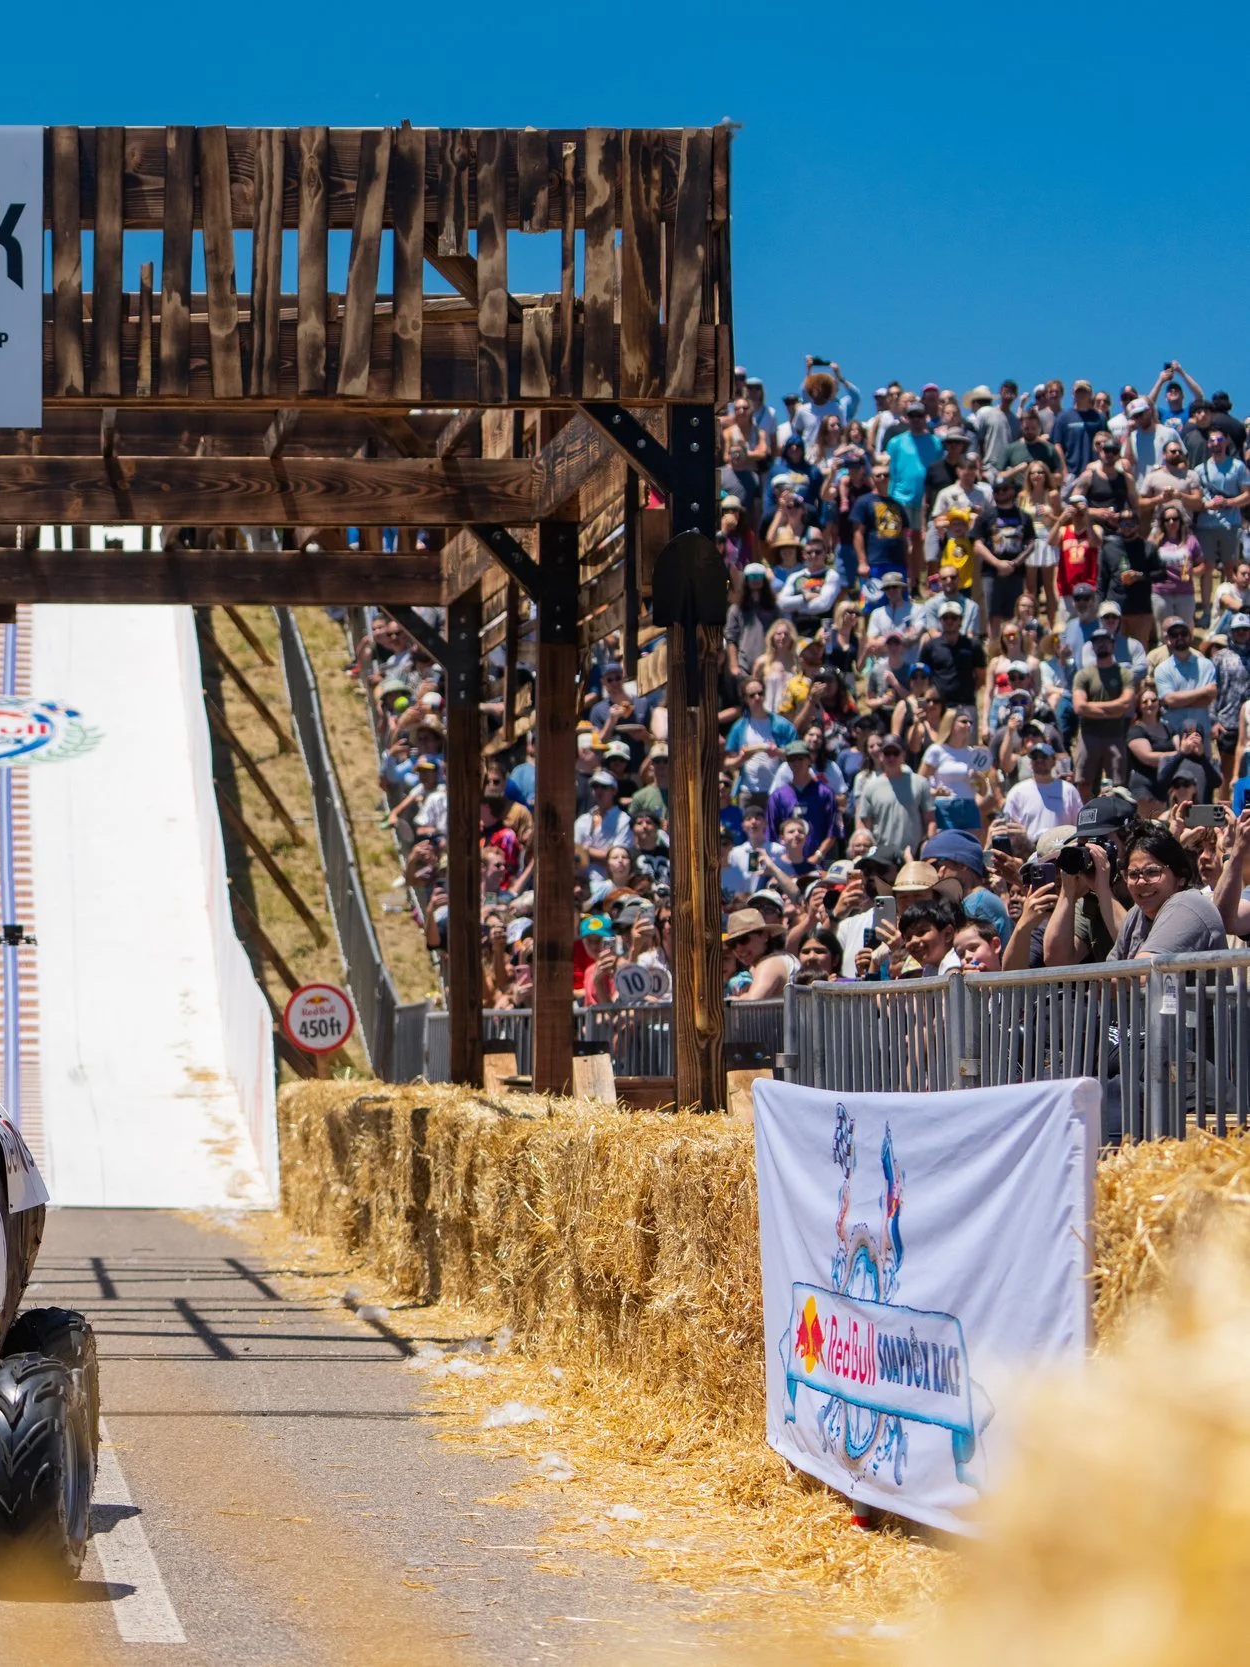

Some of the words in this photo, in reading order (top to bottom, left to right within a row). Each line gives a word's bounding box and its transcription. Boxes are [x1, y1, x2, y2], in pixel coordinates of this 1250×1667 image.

[621, 971, 646, 995] 10
[827, 1314, 852, 1376] Red
[851, 1320, 876, 1386] Bull
[877, 1328, 931, 1391] SOAPBOX
[931, 1342, 961, 1397] RACE
